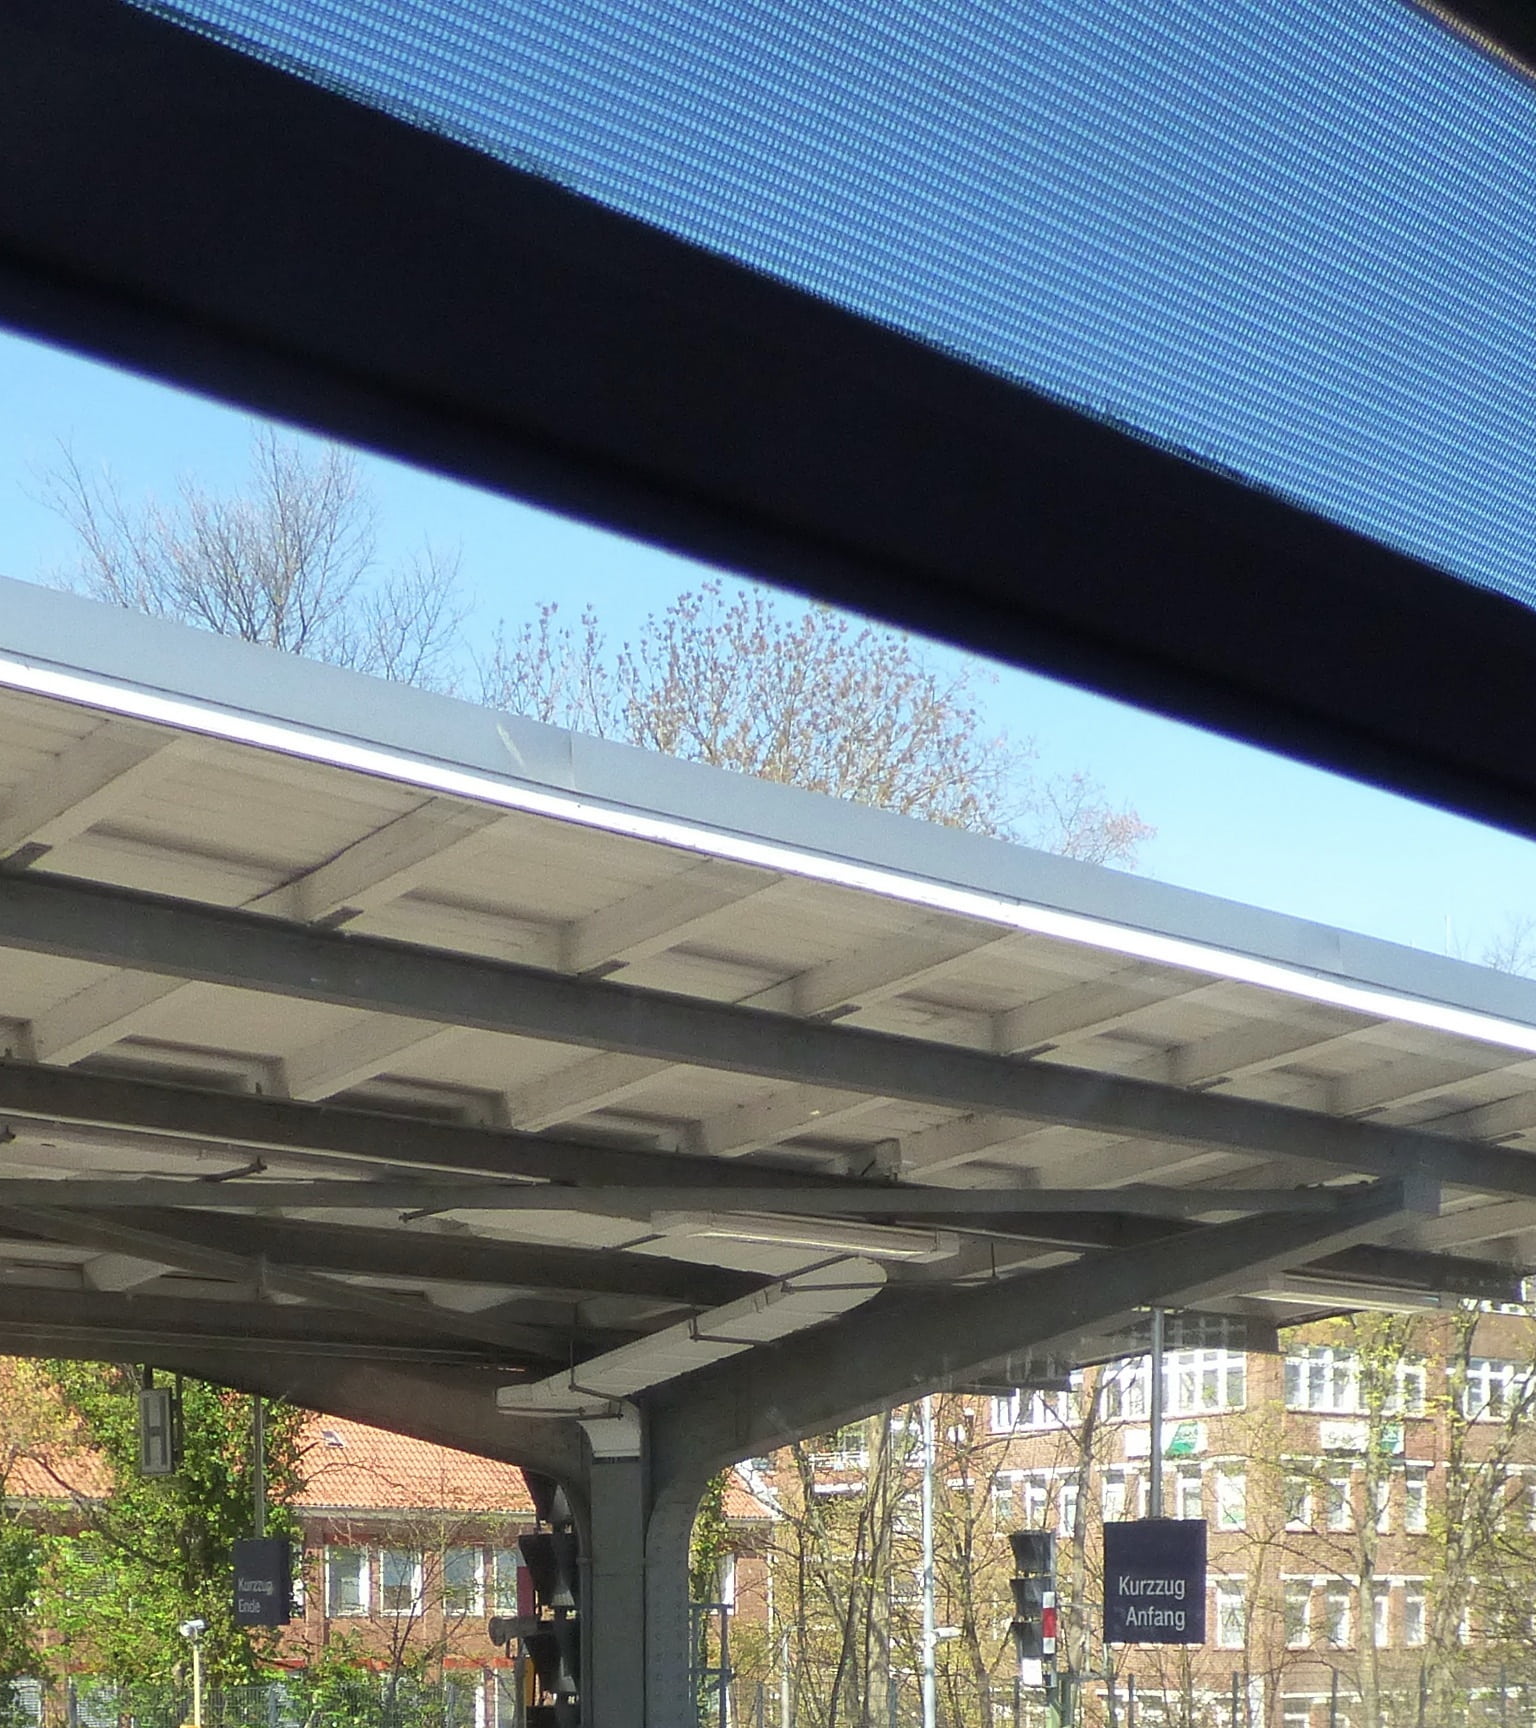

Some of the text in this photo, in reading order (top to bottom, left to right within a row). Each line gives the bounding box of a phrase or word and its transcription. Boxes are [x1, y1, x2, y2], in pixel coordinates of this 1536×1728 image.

[238, 1578, 273, 1595] Kurzzug
[1119, 1575, 1185, 1600] Kurzzug
[238, 1599, 261, 1613] Ende
[1125, 1606, 1185, 1631] Anfang
